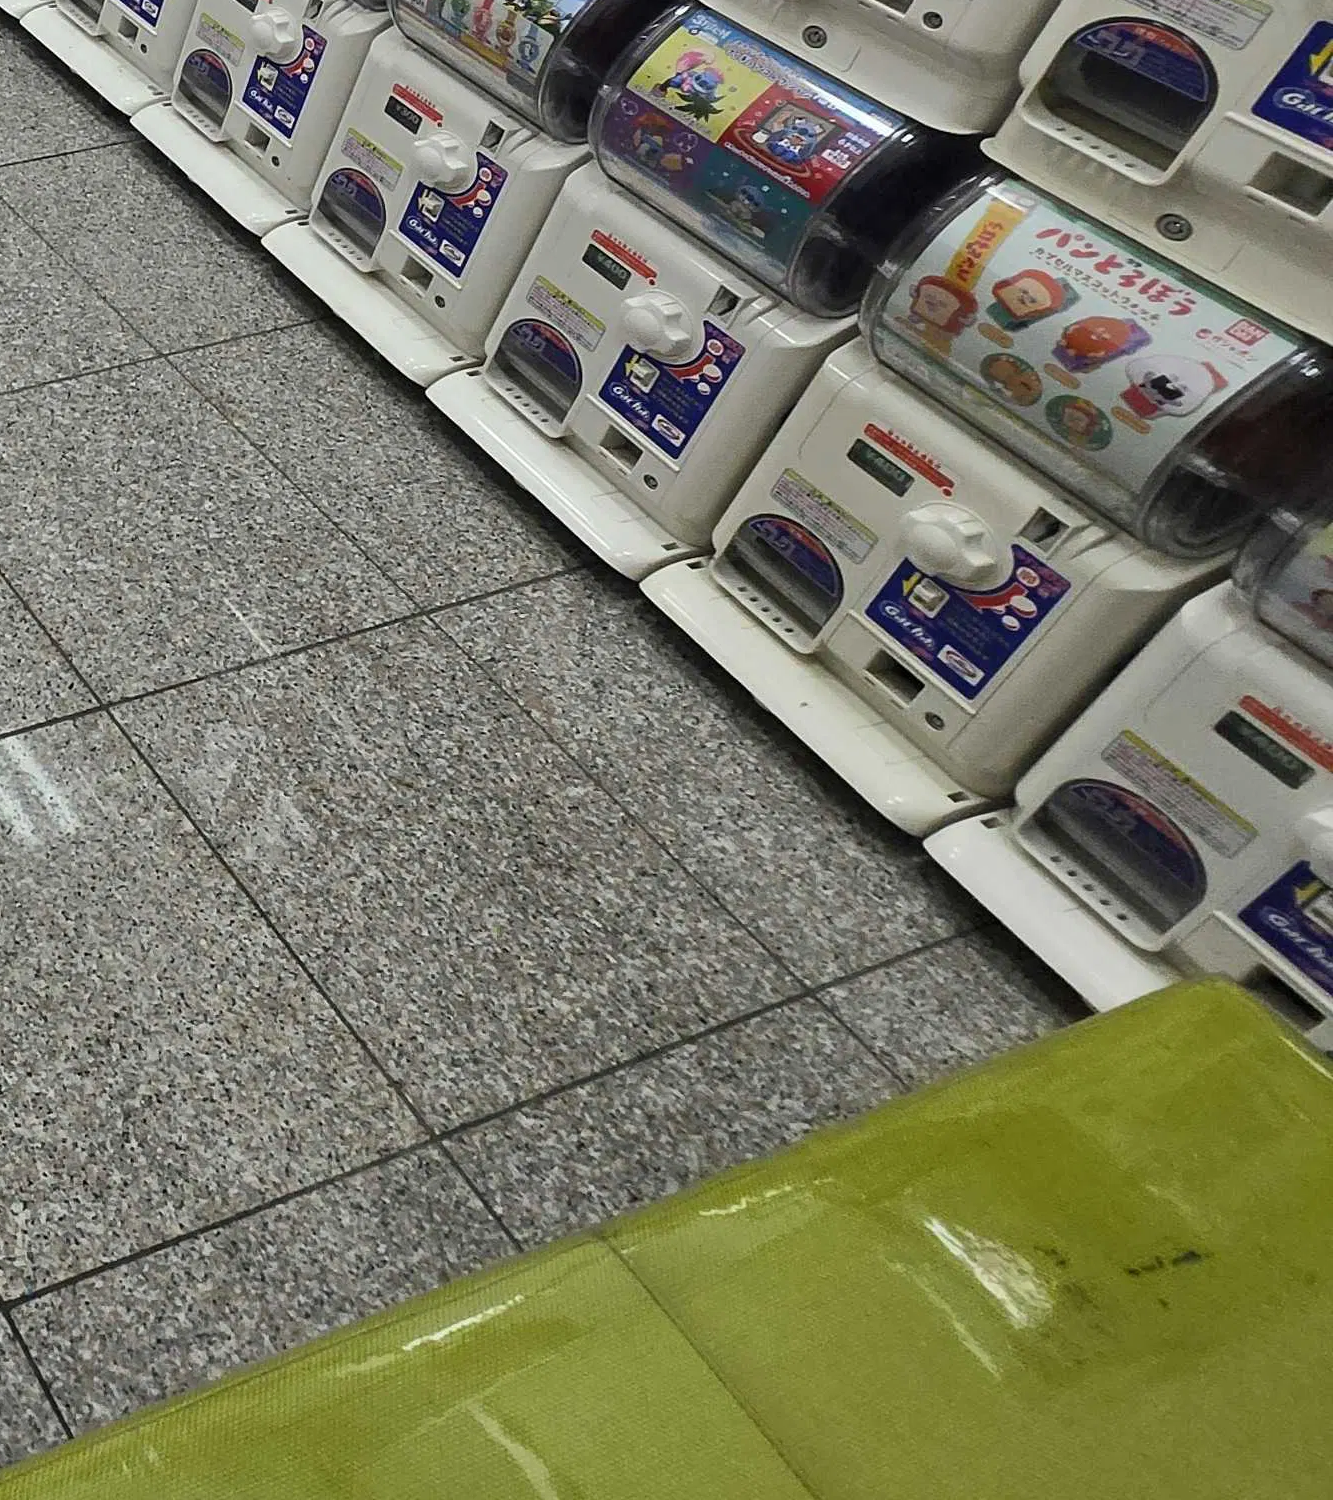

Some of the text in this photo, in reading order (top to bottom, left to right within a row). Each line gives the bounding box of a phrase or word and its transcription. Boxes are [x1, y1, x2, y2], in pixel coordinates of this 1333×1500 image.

[395, 104, 420, 126] ¥300
[596, 251, 628, 280] ¥400
[1035, 226, 1198, 318] パンどろぼう
